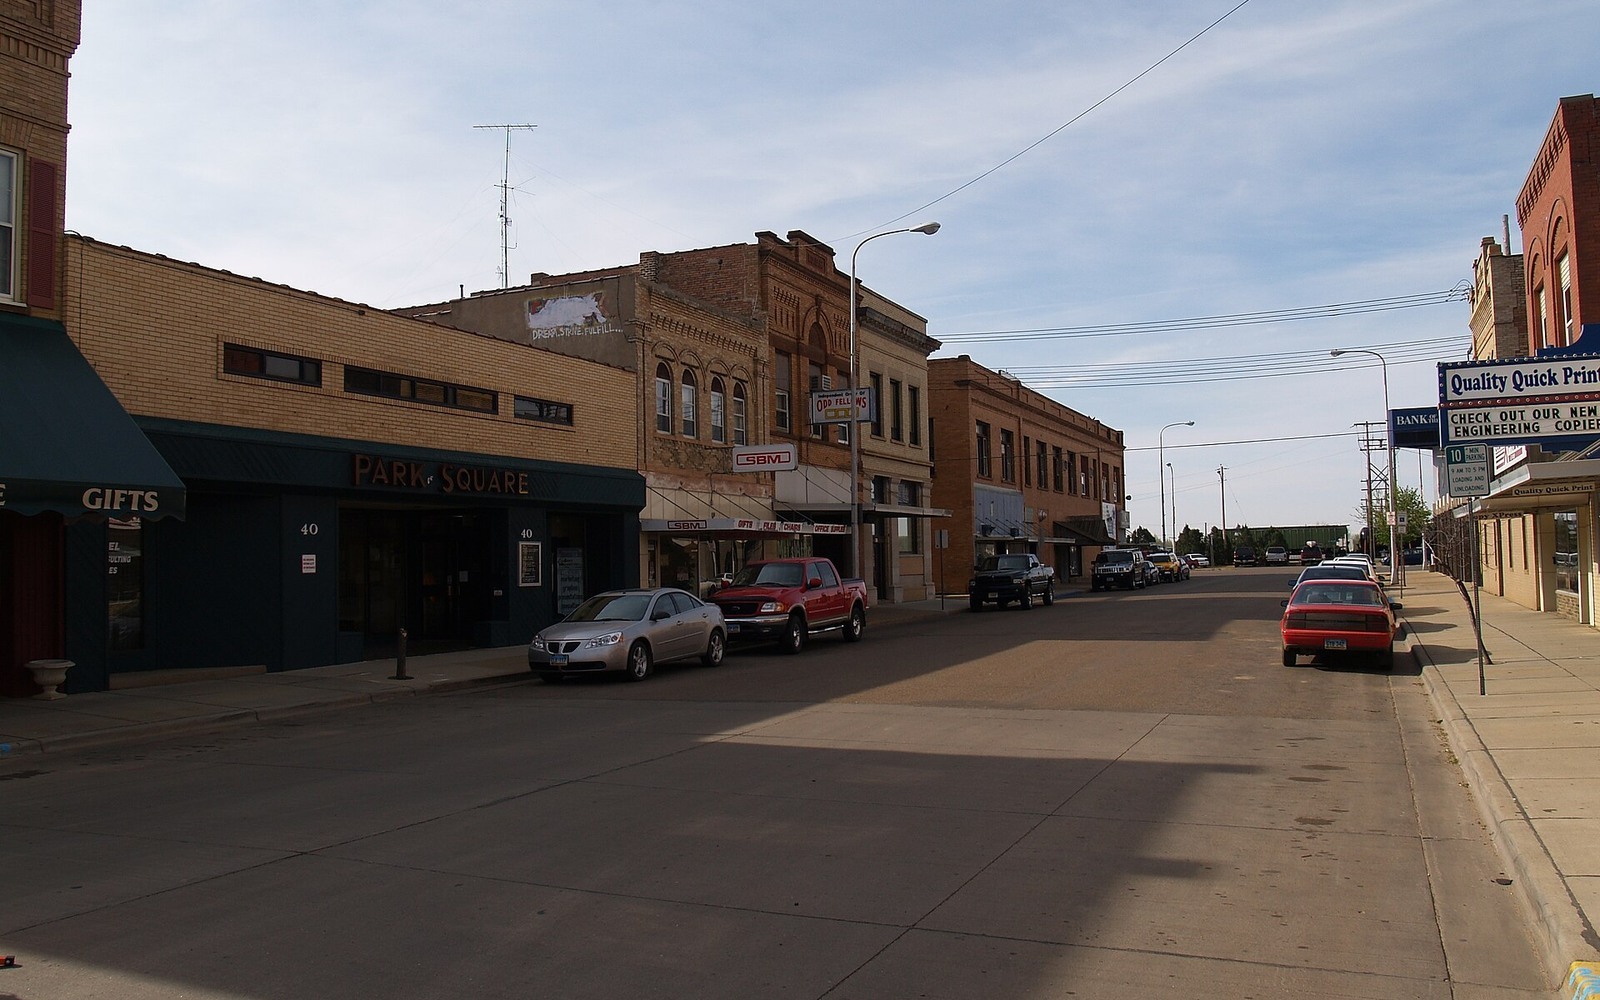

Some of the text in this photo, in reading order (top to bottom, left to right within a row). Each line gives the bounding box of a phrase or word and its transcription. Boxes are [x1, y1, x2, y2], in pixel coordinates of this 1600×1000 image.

[1451, 373, 1508, 396] Quality
[1512, 368, 1559, 392] Quick
[817, 397, 866, 412] ODD FELLWS
[1396, 414, 1428, 426] BANK
[1451, 406, 1597, 425] CHECK OUT OUR NEW
[1454, 422, 1540, 437] ENGINEERING
[746, 455, 782, 465] SBM
[1451, 449, 1462, 462] 10
[353, 453, 529, 494] PARK SQUARE
[1514, 488, 1543, 496] Quality
[82, 487, 159, 512] GIFTS
[300, 522, 319, 536] 40
[674, 522, 701, 530] SBM
[738, 519, 753, 529] GIFTS
[520, 528, 533, 539] 40
